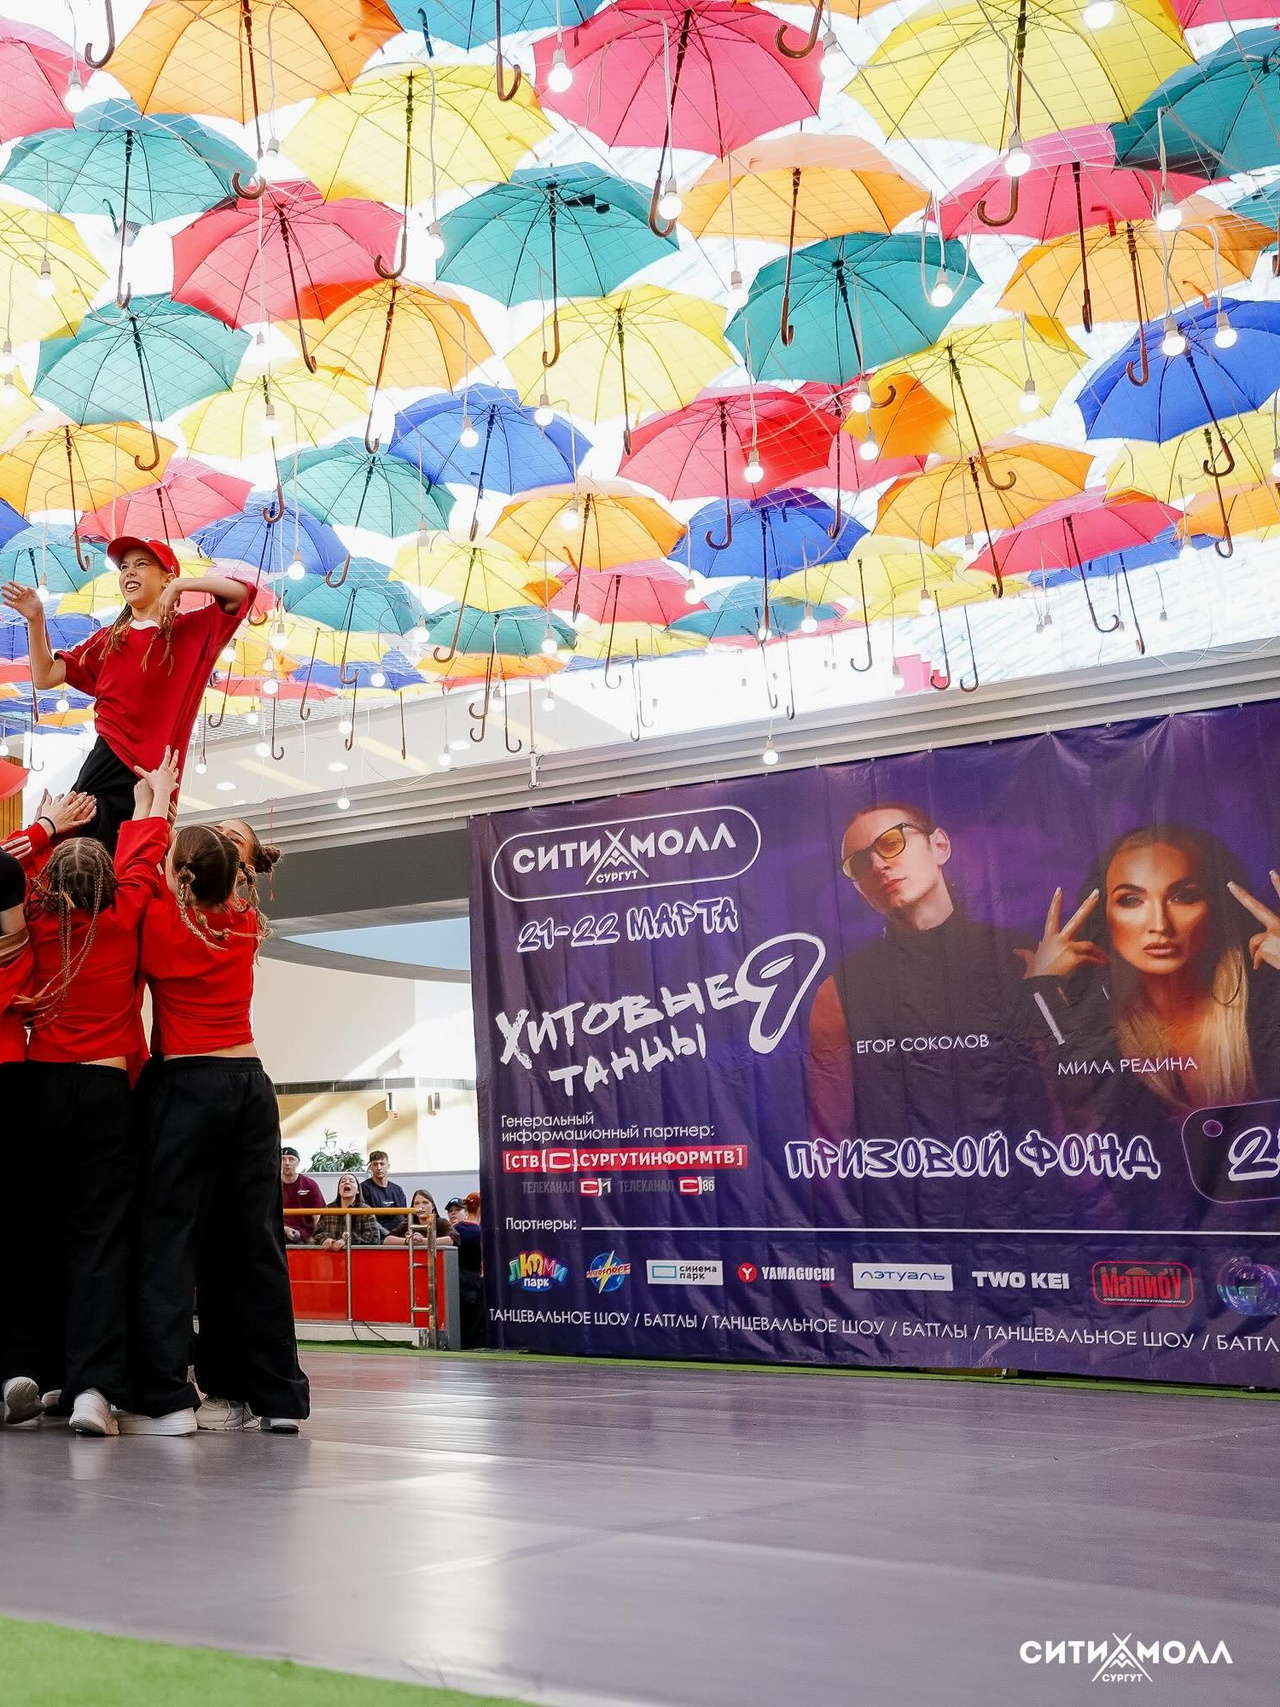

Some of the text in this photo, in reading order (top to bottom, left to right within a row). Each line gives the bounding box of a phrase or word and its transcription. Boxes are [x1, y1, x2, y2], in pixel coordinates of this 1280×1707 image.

[513, 822, 737, 874] СИТИ МОЛЛ
[595, 870, 639, 884] СУРГУТ
[517, 896, 739, 952] 21-22 МАРТА
[496, 974, 742, 1069] ХИТОВЫЕ
[856, 1034, 990, 1054] ЕГОР СОКОЛОВ
[549, 1023, 706, 1096] ТАНЦЫ
[1057, 1056, 1198, 1076] МИЛА РЕДИНА
[501, 1112, 594, 1129] Генеральный
[501, 1124, 716, 1143] информационный партнер:
[785, 1129, 1162, 1180] ПРИЗОВОЙ ФОНД
[1228, 1126, 1280, 1182] 2
[521, 1180, 575, 1194] ТЕЛЕКАНАЛ
[619, 1179, 673, 1193] ТЕЛЕКАНАЛ
[505, 1217, 577, 1232] Партнеры:
[508, 1252, 569, 1283] ЛЮМИ
[679, 1265, 717, 1273] синема
[679, 1273, 705, 1281] парк
[761, 1267, 835, 1281] YAMAGUCHI
[523, 1277, 550, 1289] парк
[972, 1271, 1069, 1289] TWO KEI
[489, 1308, 591, 1324] ТАНЦЕВАЛЬНОЕ
[594, 1312, 630, 1326] ШОУ
[644, 1313, 698, 1328] БАТТЛЫ
[712, 1316, 837, 1333] ТАНЦЕВАЛЬНОЕ
[842, 1320, 885, 1336] ШОУ
[902, 1322, 968, 1338] БАТТЛЫ
[985, 1325, 1138, 1345] ТАНЦЕВАЛЬНОЕ
[1143, 1332, 1195, 1350] ШОУ
